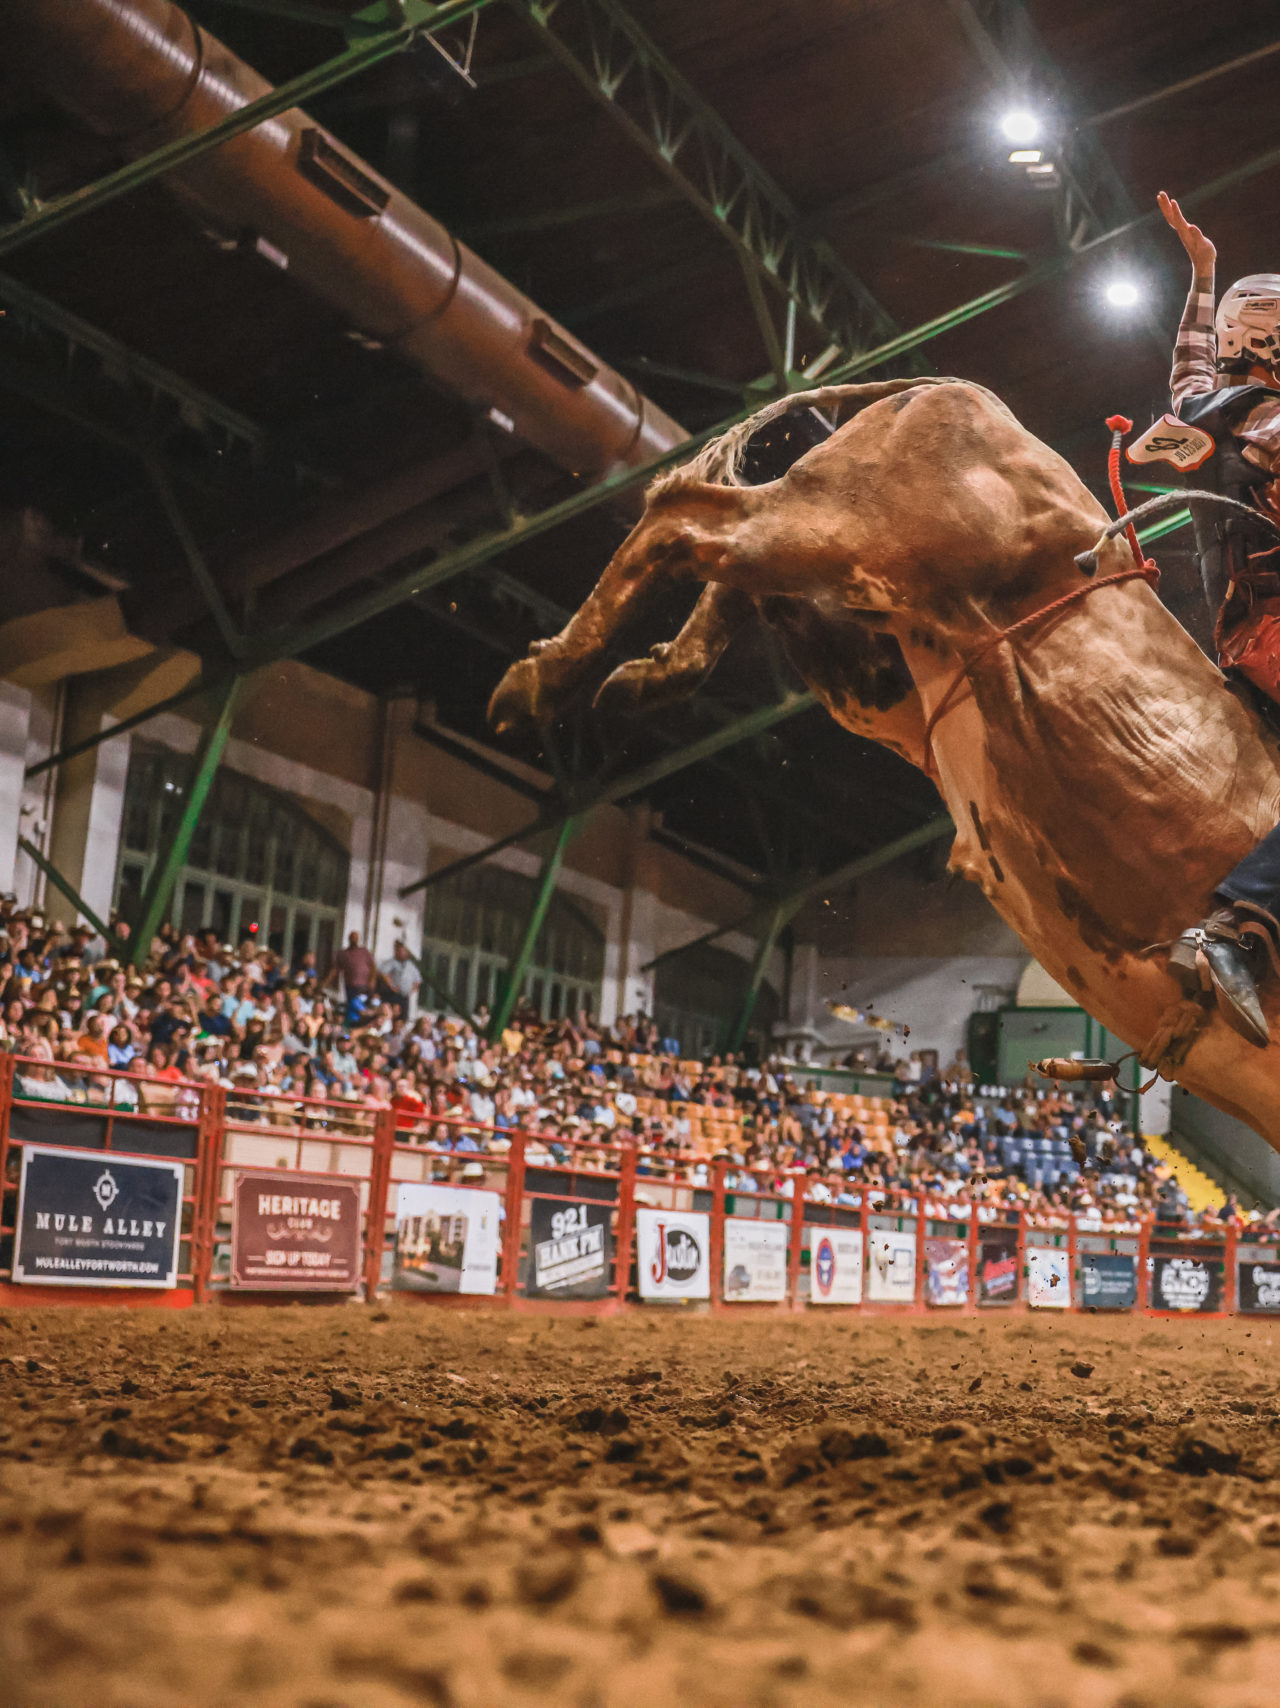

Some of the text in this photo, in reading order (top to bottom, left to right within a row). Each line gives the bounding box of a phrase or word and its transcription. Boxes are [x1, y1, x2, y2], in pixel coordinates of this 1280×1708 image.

[258, 1194, 341, 1221] HERITAGE
[36, 1212, 167, 1238] MULE ALLEY
